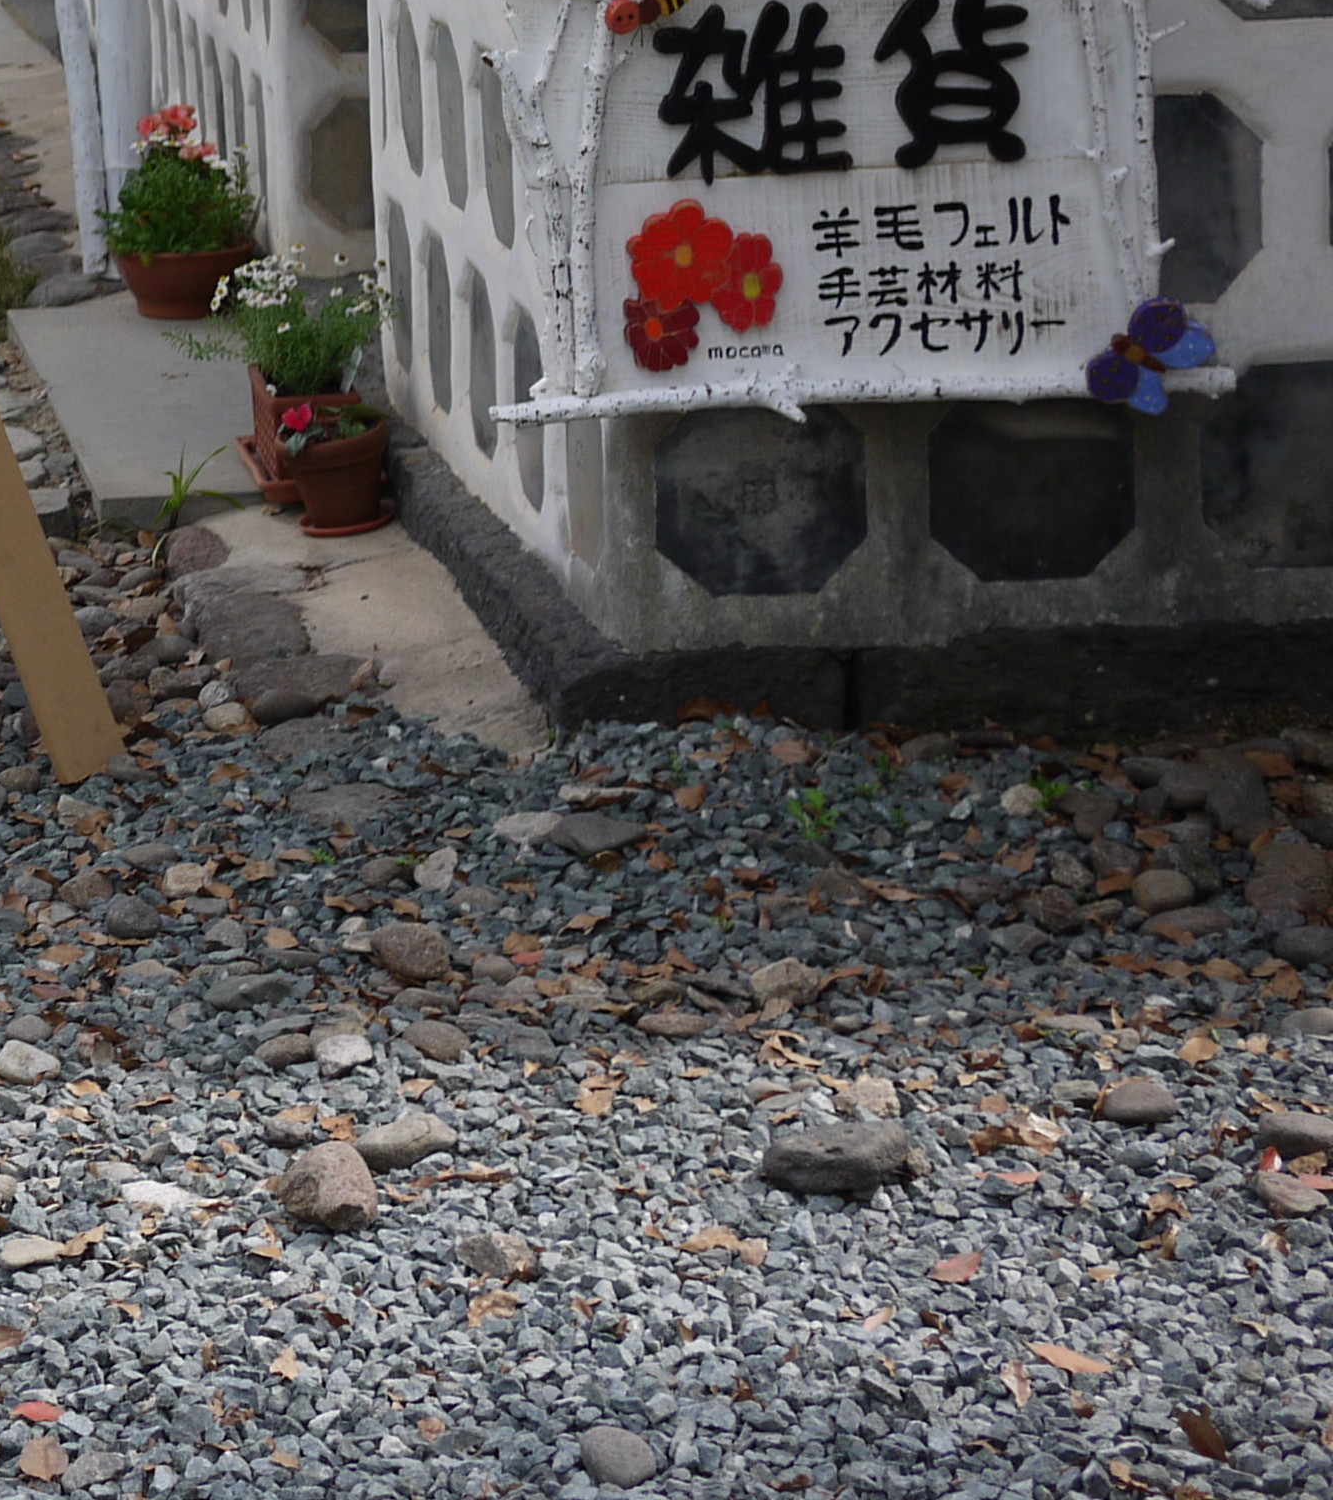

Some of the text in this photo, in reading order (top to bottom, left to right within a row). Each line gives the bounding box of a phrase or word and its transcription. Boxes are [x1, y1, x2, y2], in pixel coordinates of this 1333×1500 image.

[811, 193, 1072, 257] 羊毛フェルト
[818, 260, 1024, 305] 手芸材料
[823, 311, 1067, 358] アクセサリー
